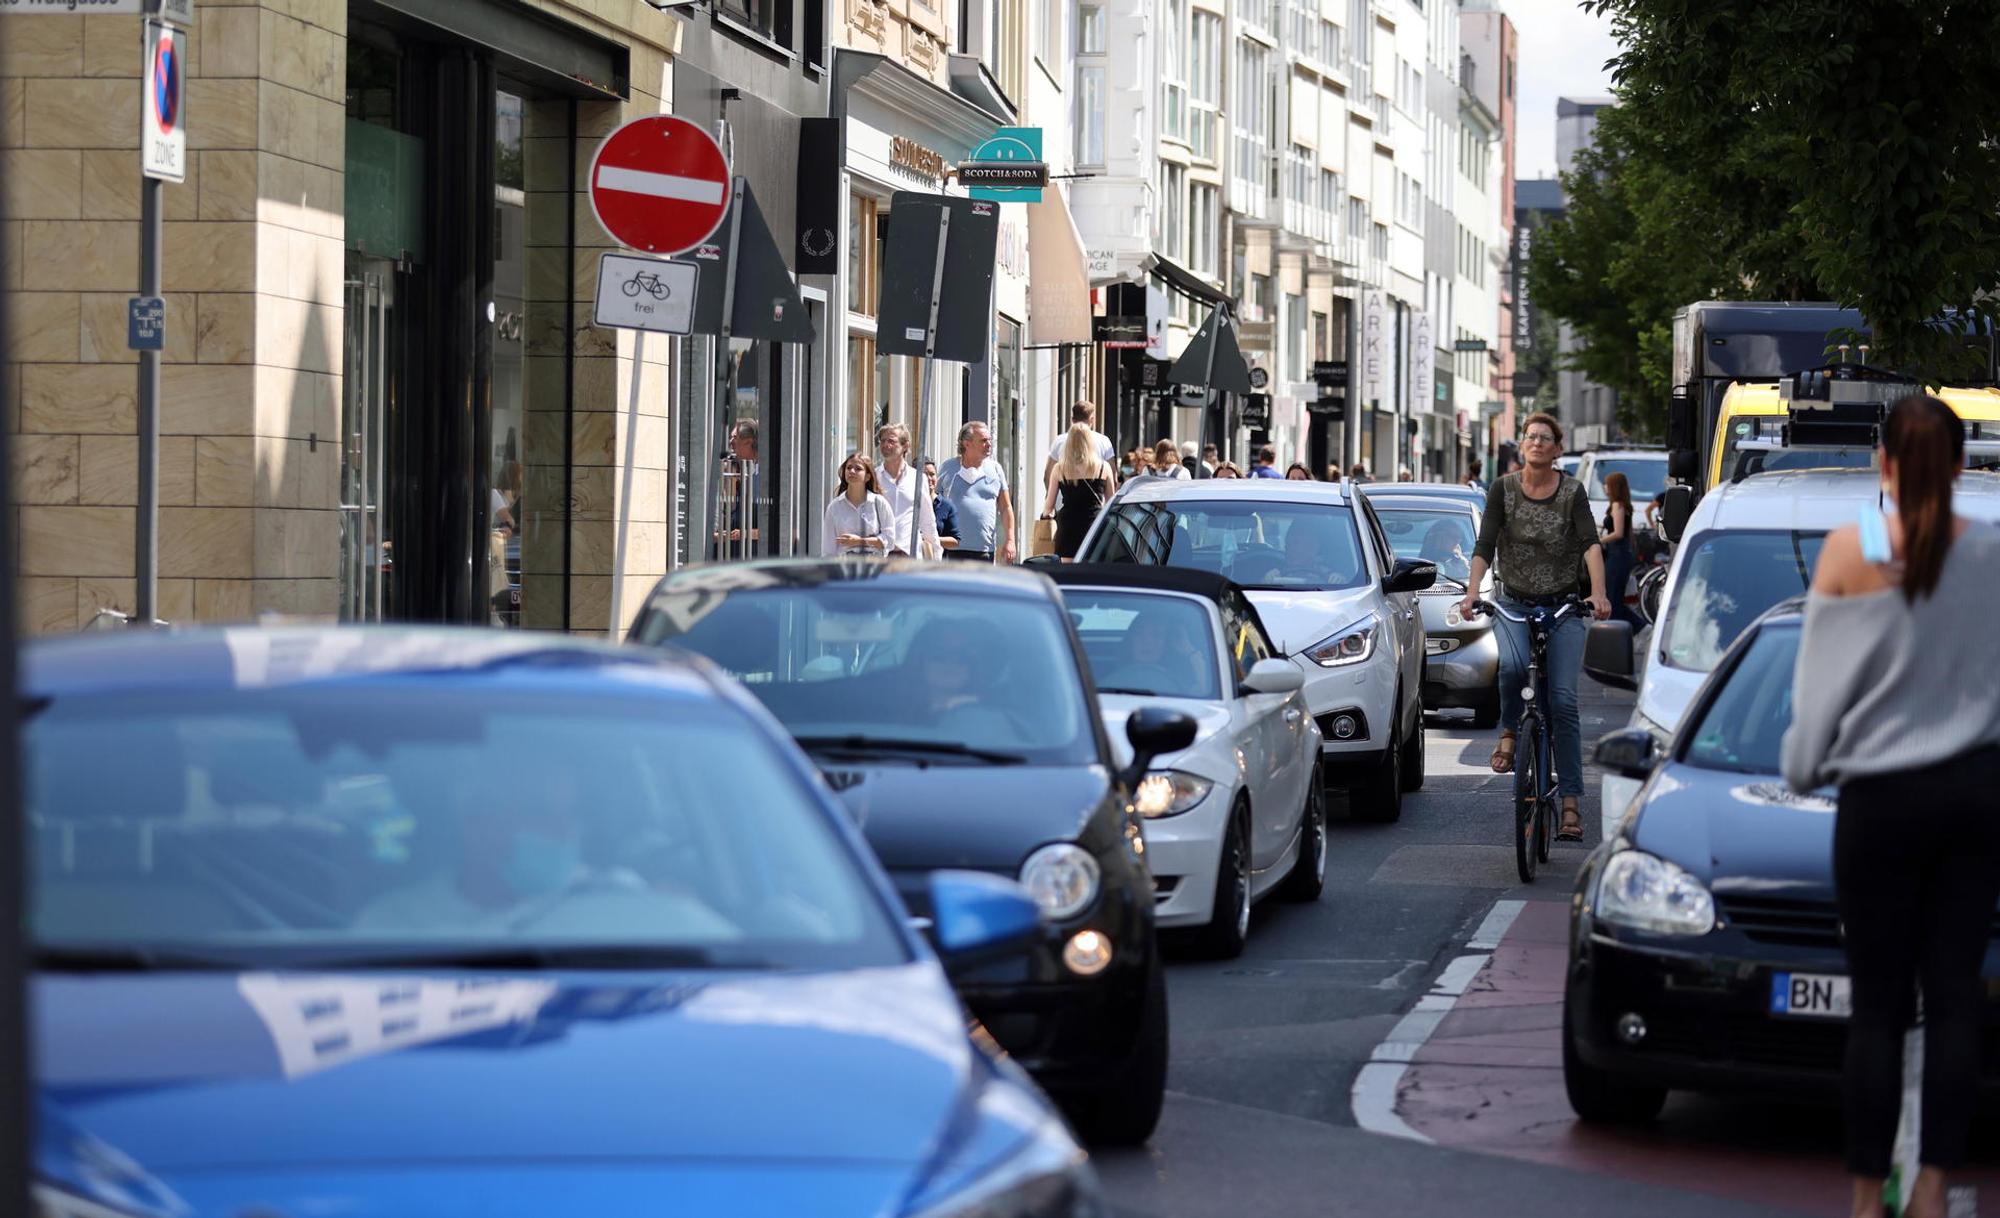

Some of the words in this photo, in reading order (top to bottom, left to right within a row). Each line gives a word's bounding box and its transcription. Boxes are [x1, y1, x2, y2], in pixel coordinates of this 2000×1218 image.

[154, 140, 176, 168] ZONE
[964, 168, 1038, 179] SCOTCH&SODA
[634, 302, 655, 314] frei
[1098, 325, 1144, 333] MAC
[1367, 293, 1381, 397] ARKET
[1416, 315, 1430, 411] ARKET
[1791, 979, 1833, 1011] BN
